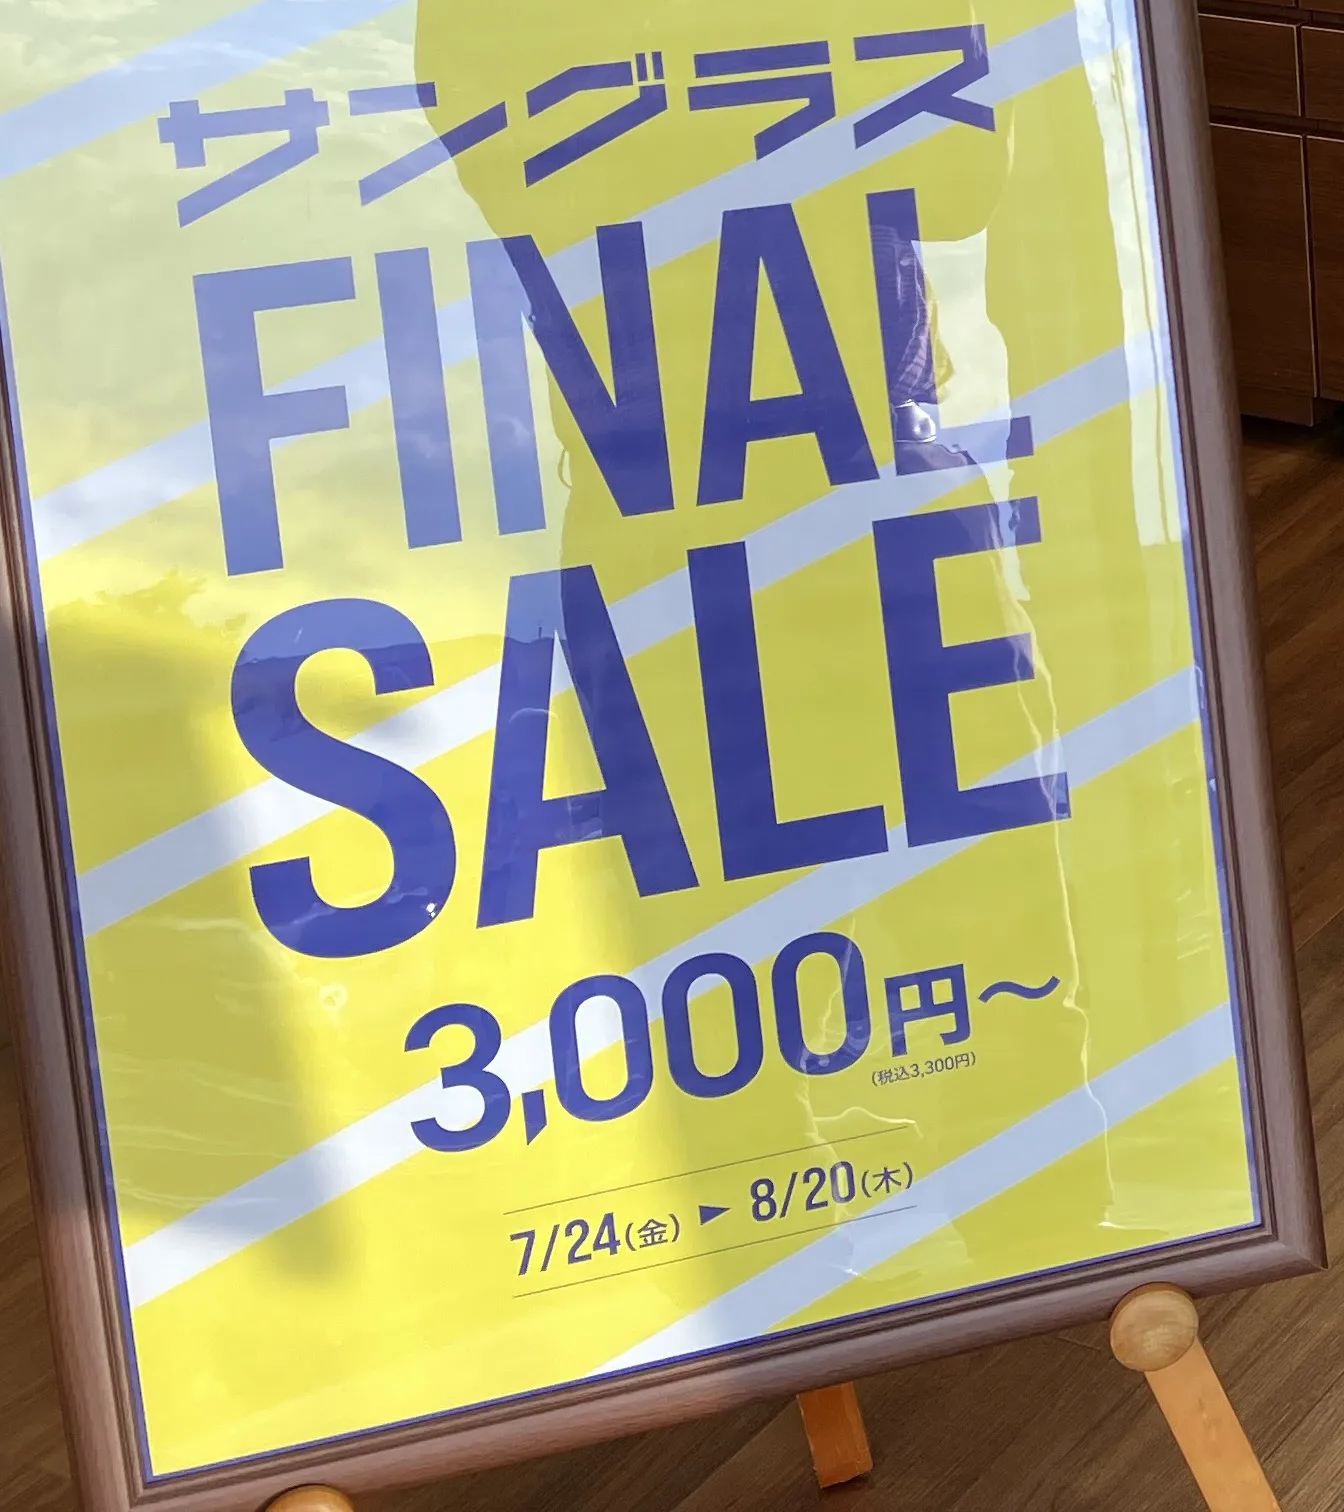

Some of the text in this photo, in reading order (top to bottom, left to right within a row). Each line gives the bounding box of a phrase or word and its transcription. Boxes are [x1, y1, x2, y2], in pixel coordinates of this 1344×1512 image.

[157, 24, 996, 227] サングラス
[192, 186, 1034, 578] FINAL
[230, 496, 1072, 961] SALE
[871, 1051, 977, 1088] (税込3,300円)
[510, 1161, 915, 1277] 7/24(金) 8/20(木)
